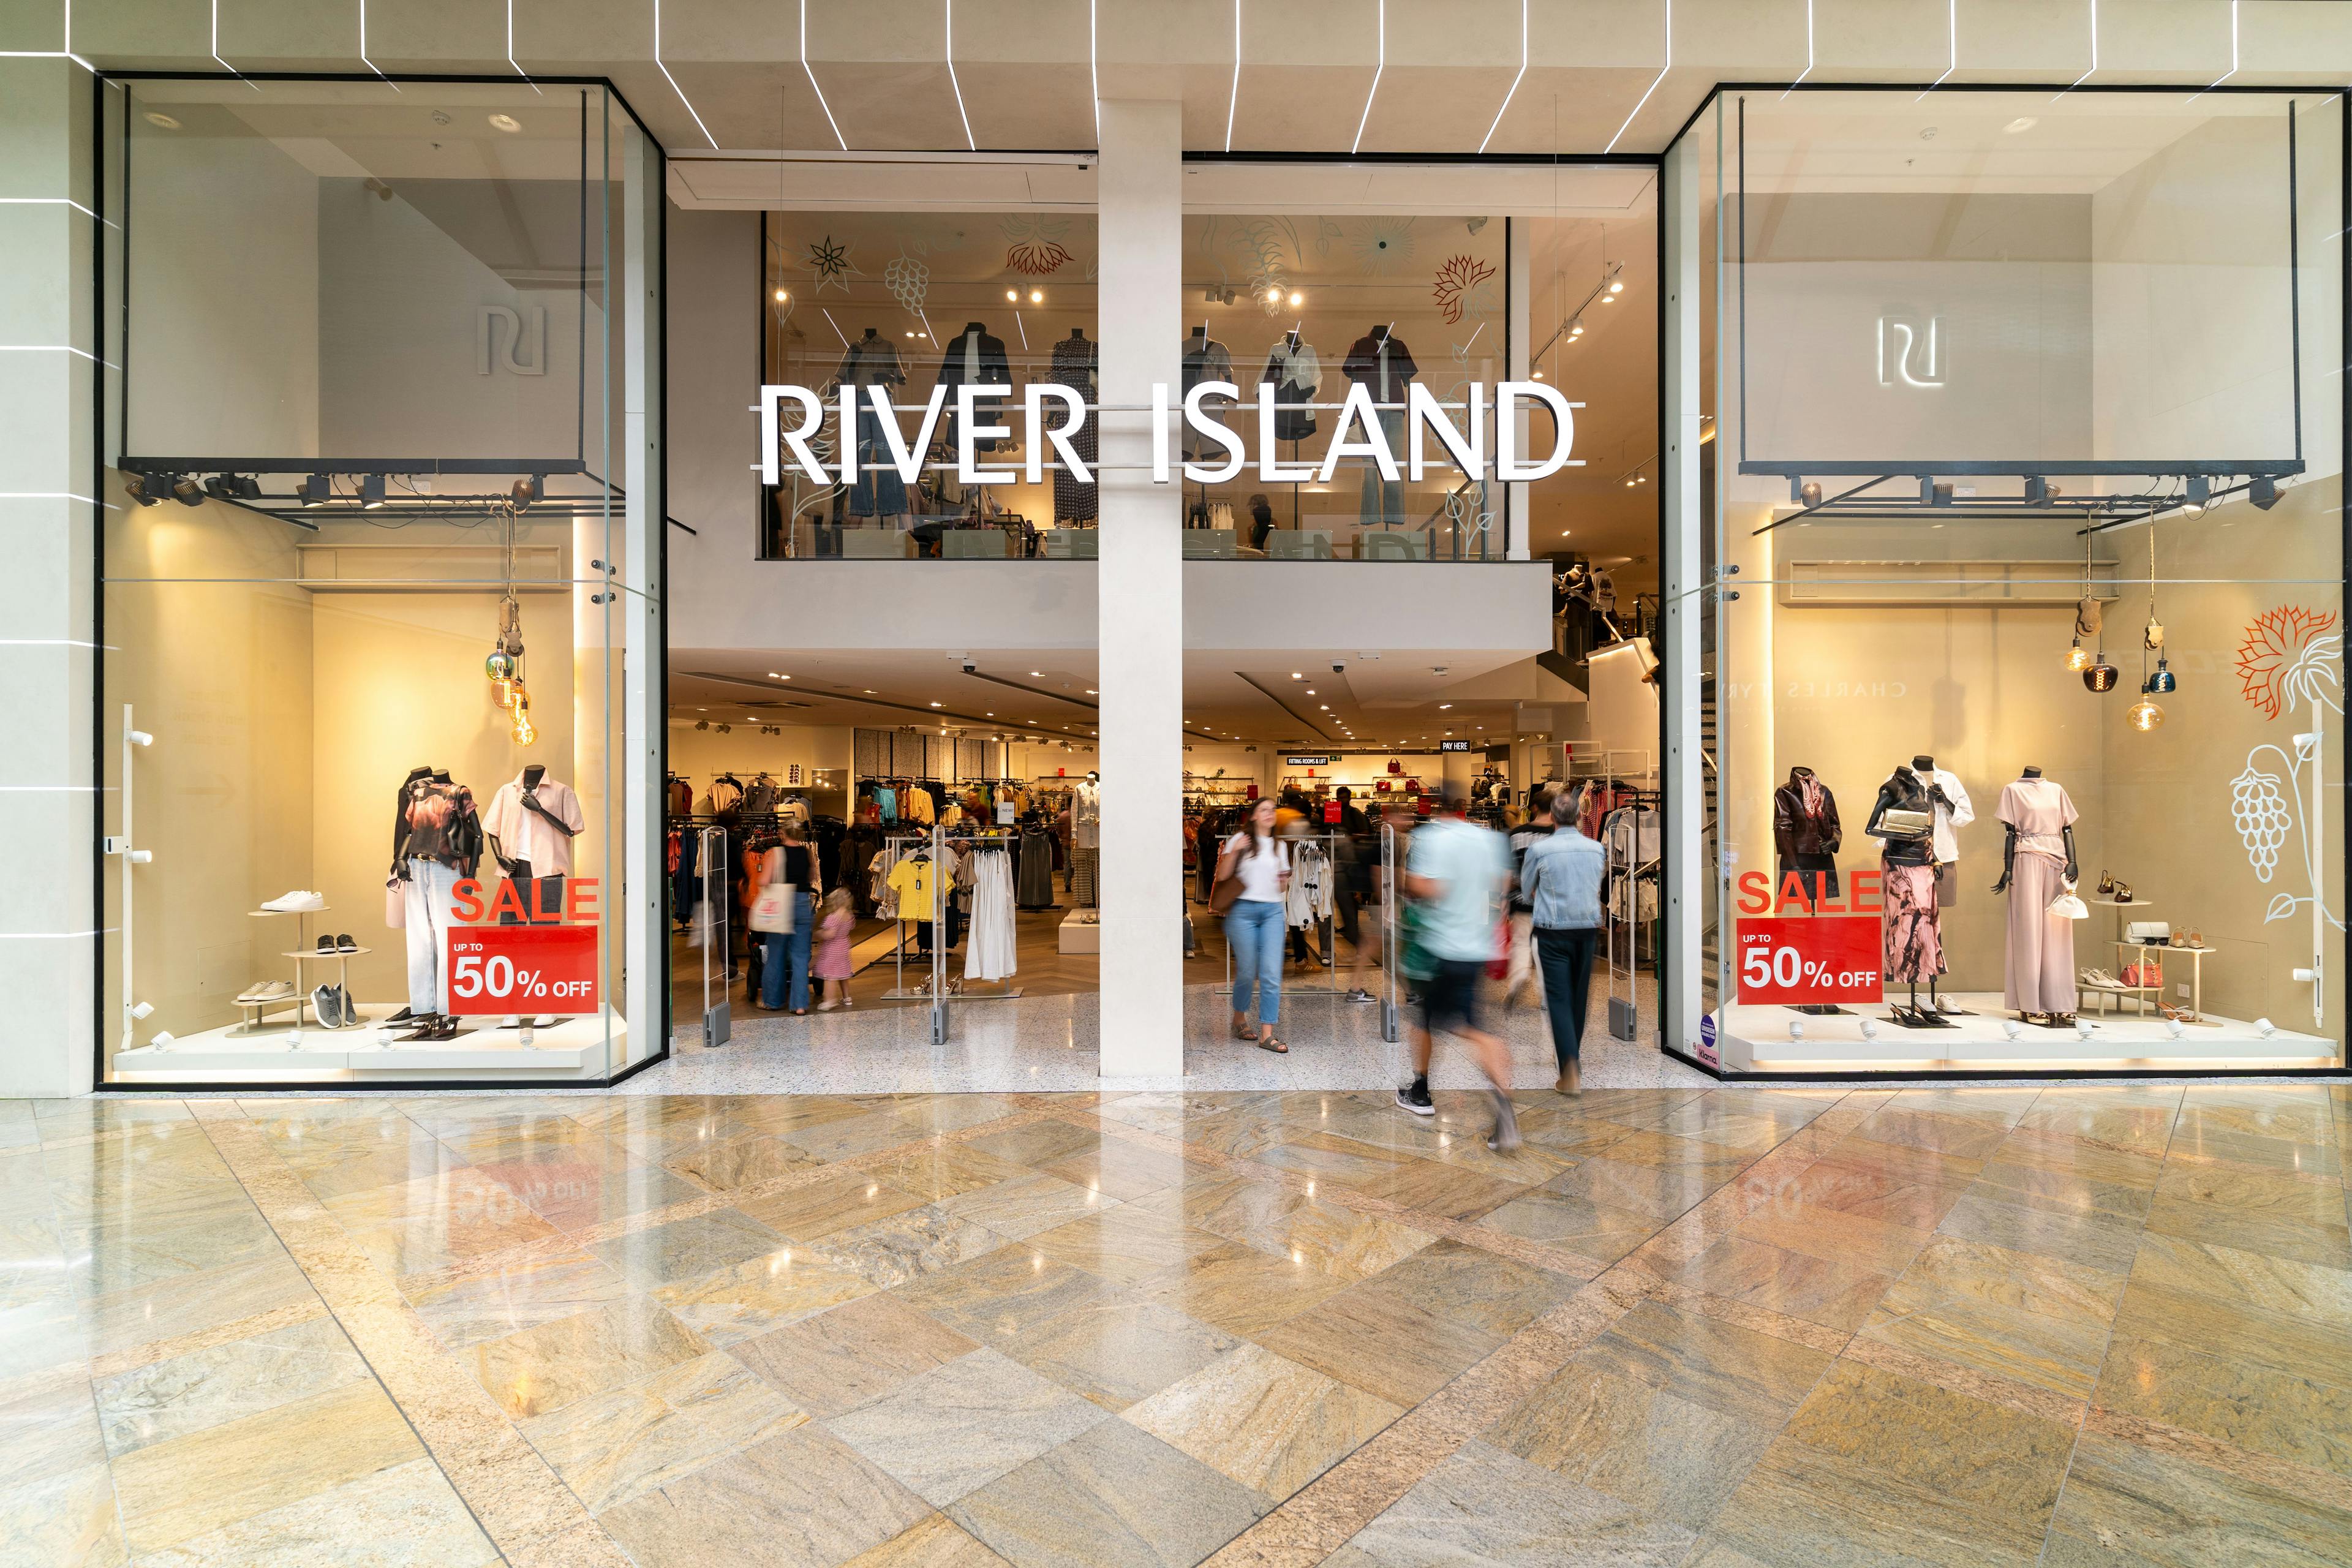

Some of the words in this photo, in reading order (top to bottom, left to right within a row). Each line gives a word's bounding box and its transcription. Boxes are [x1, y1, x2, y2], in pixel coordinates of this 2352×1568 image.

[761, 383, 1095, 486] RIVER
[1152, 380, 1574, 484] ISLAND
[1442, 742, 1453, 750] PAY
[1453, 742, 1468, 750] HERE
[451, 878, 600, 922] SALE
[1737, 870, 1882, 914] SALE
[453, 955, 547, 998] 50%
[552, 981, 592, 997] OFF
[1743, 946, 1833, 988] 50%
[1838, 971, 1877, 987] OFF
[1699, 1048, 1718, 1065] Klarna.
